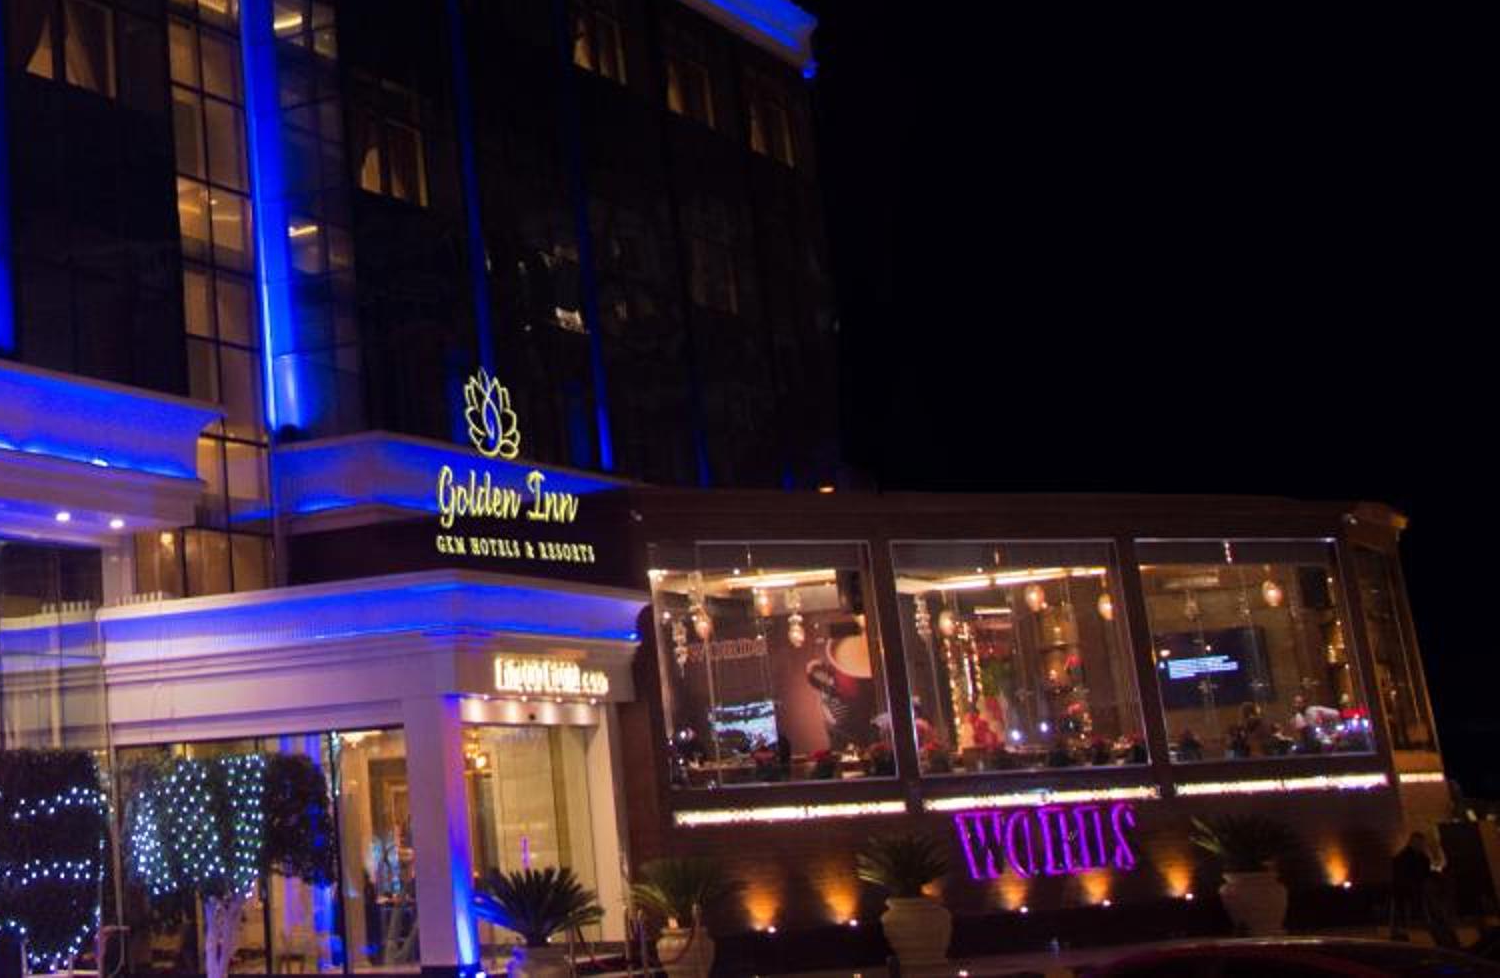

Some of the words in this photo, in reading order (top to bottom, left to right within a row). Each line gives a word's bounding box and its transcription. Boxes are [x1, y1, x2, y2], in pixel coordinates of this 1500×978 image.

[437, 465, 521, 528] Golden
[526, 470, 579, 522] Inn
[469, 536, 520, 558] HOTELS
[524, 540, 535, 559] &
[538, 541, 595, 563] RESORTS
